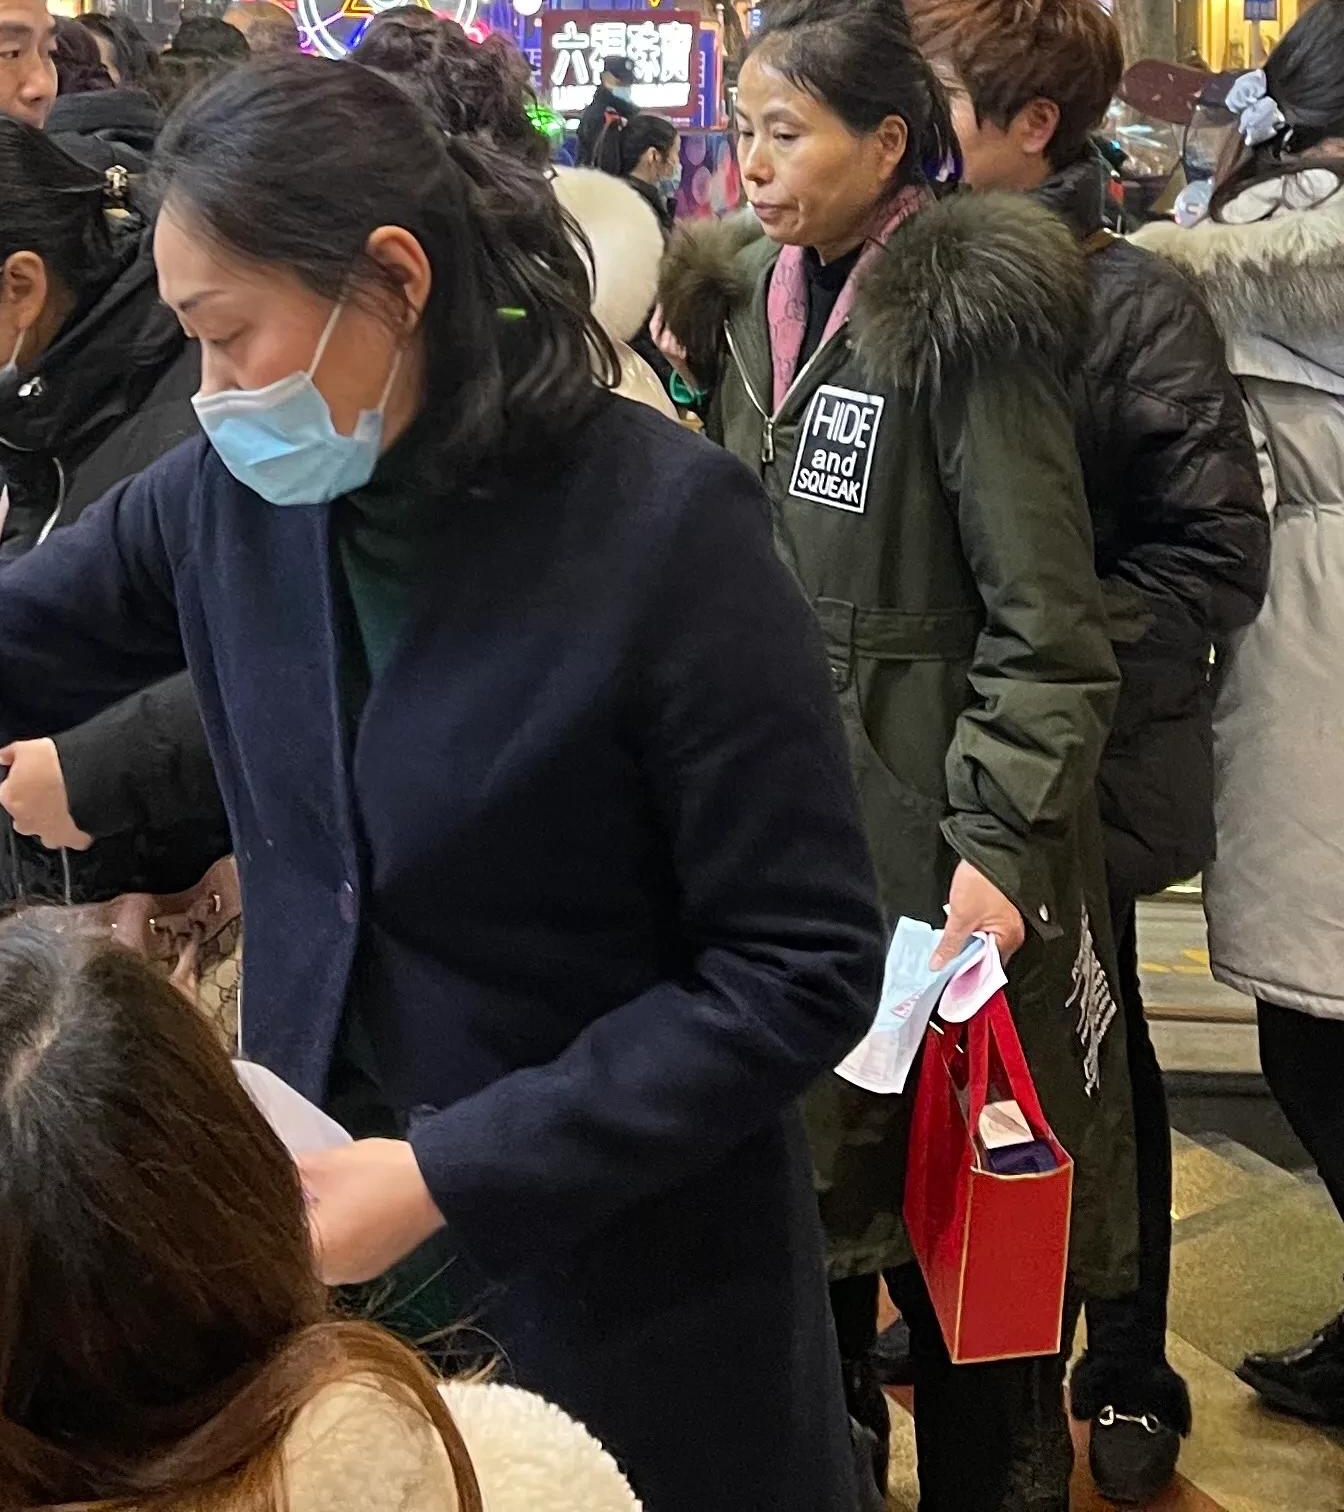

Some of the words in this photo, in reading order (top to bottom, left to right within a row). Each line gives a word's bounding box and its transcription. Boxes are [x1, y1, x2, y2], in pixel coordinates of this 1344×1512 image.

[812, 396, 874, 449] HIDE
[811, 448, 858, 477] and
[797, 468, 861, 504] SQUEAK
